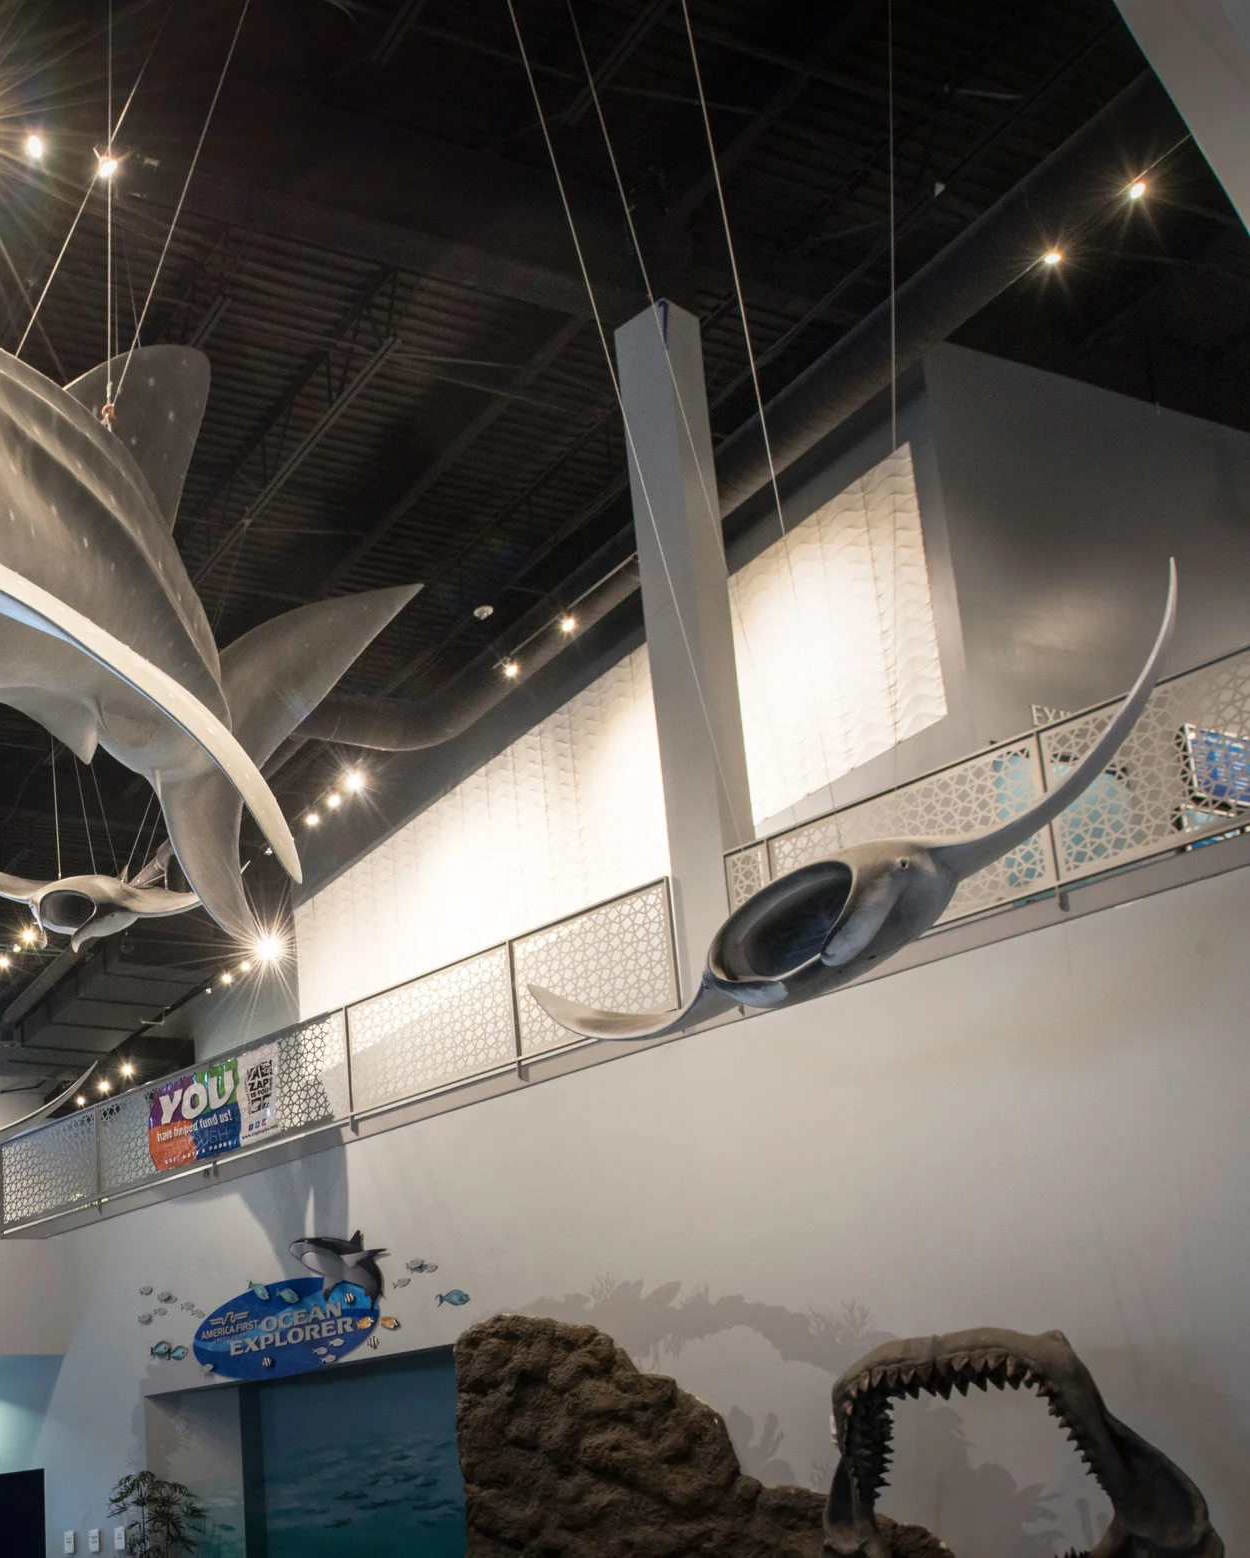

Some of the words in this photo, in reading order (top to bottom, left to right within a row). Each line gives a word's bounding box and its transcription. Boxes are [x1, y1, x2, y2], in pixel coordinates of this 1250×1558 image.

[159, 1070, 235, 1125] YOU
[248, 1077, 269, 1092] ZAP
[157, 1129, 173, 1143] have
[174, 1121, 199, 1137] helped
[199, 1113, 219, 1129] fund
[219, 1109, 233, 1124] us!
[201, 1325, 236, 1341] AMERICA
[236, 1319, 259, 1333] FIRST
[261, 1301, 343, 1332] OCEAN
[229, 1316, 355, 1357] EXPLORER
